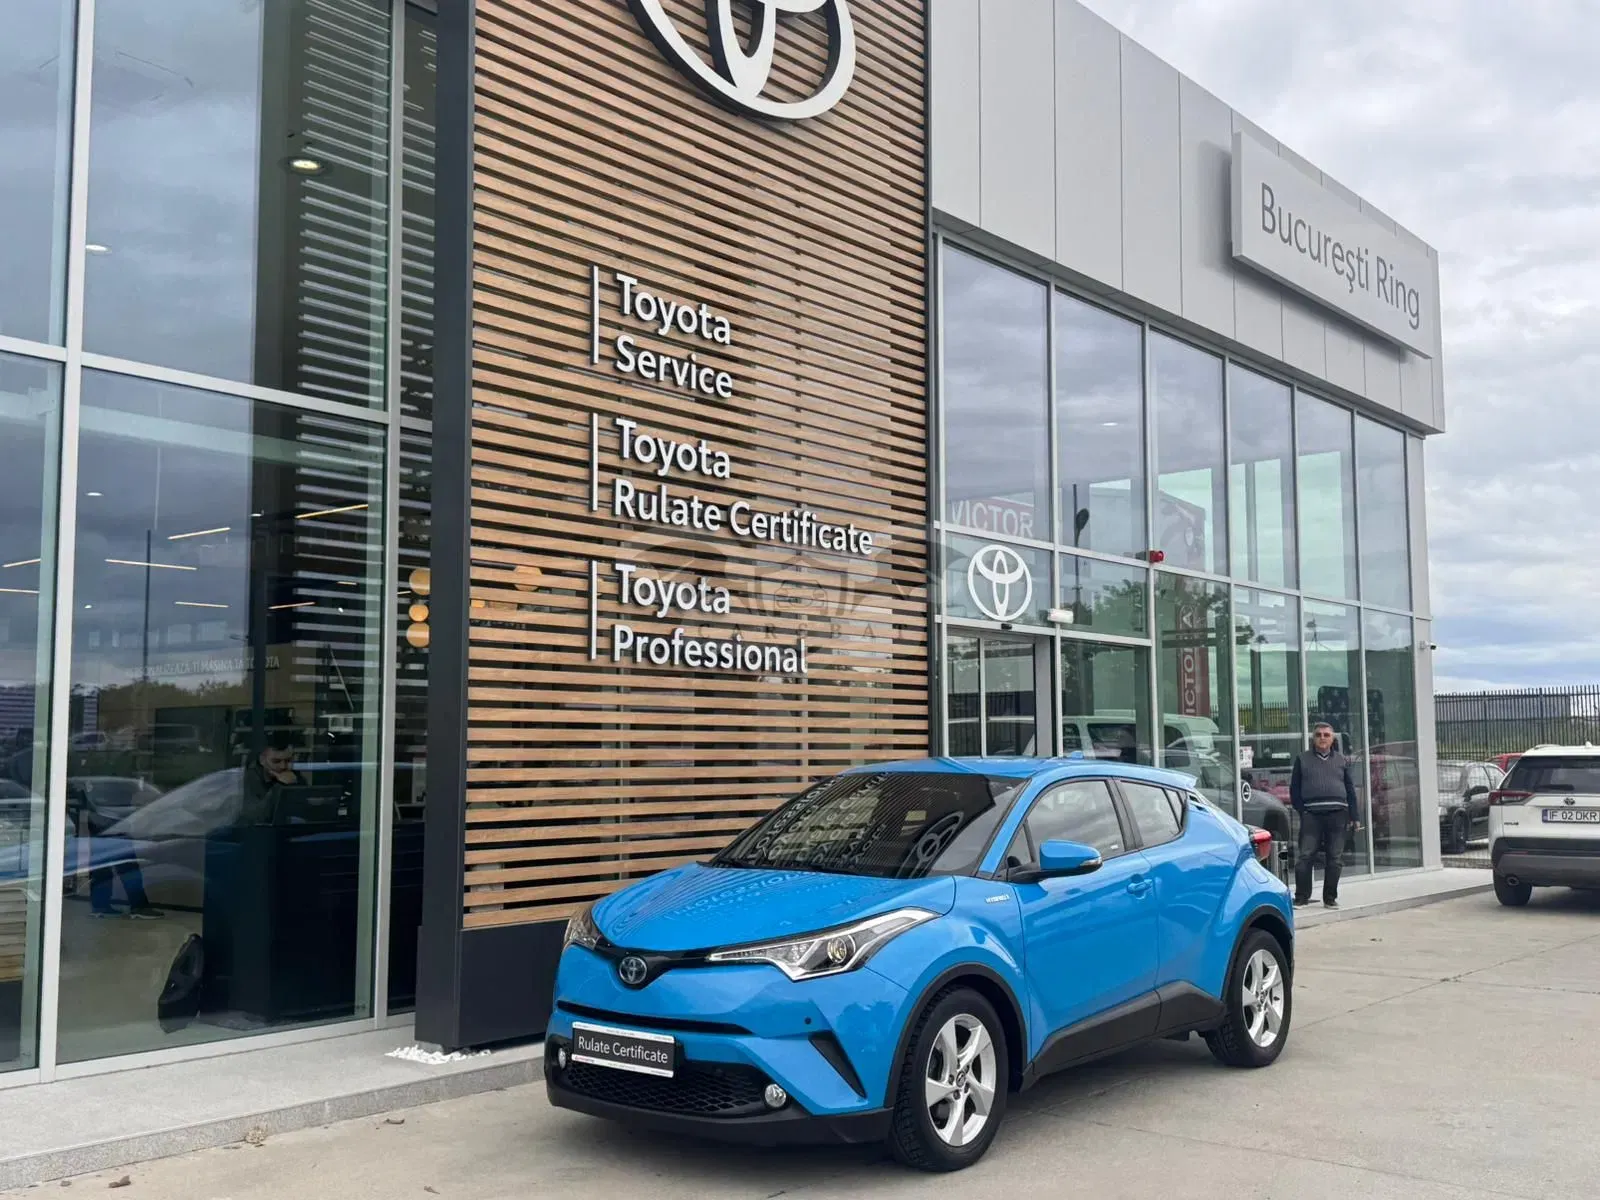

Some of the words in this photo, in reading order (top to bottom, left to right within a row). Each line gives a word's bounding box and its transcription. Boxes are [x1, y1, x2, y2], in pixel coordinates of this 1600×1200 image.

[616, 273, 731, 345] Toyota
[1376, 255, 1420, 330] Ring
[615, 335, 733, 398] Service
[615, 418, 730, 479] Toyota
[614, 479, 721, 531] Rulate
[730, 502, 873, 555] Certificate
[951, 500, 1033, 538] VICTOR
[615, 563, 730, 618] Toyota
[614, 625, 808, 673] Professional
[1562, 811, 1574, 820] 02
[1576, 811, 1597, 821] DKR
[578, 1036, 610, 1054] Rulate
[612, 1042, 668, 1063] Certificate
